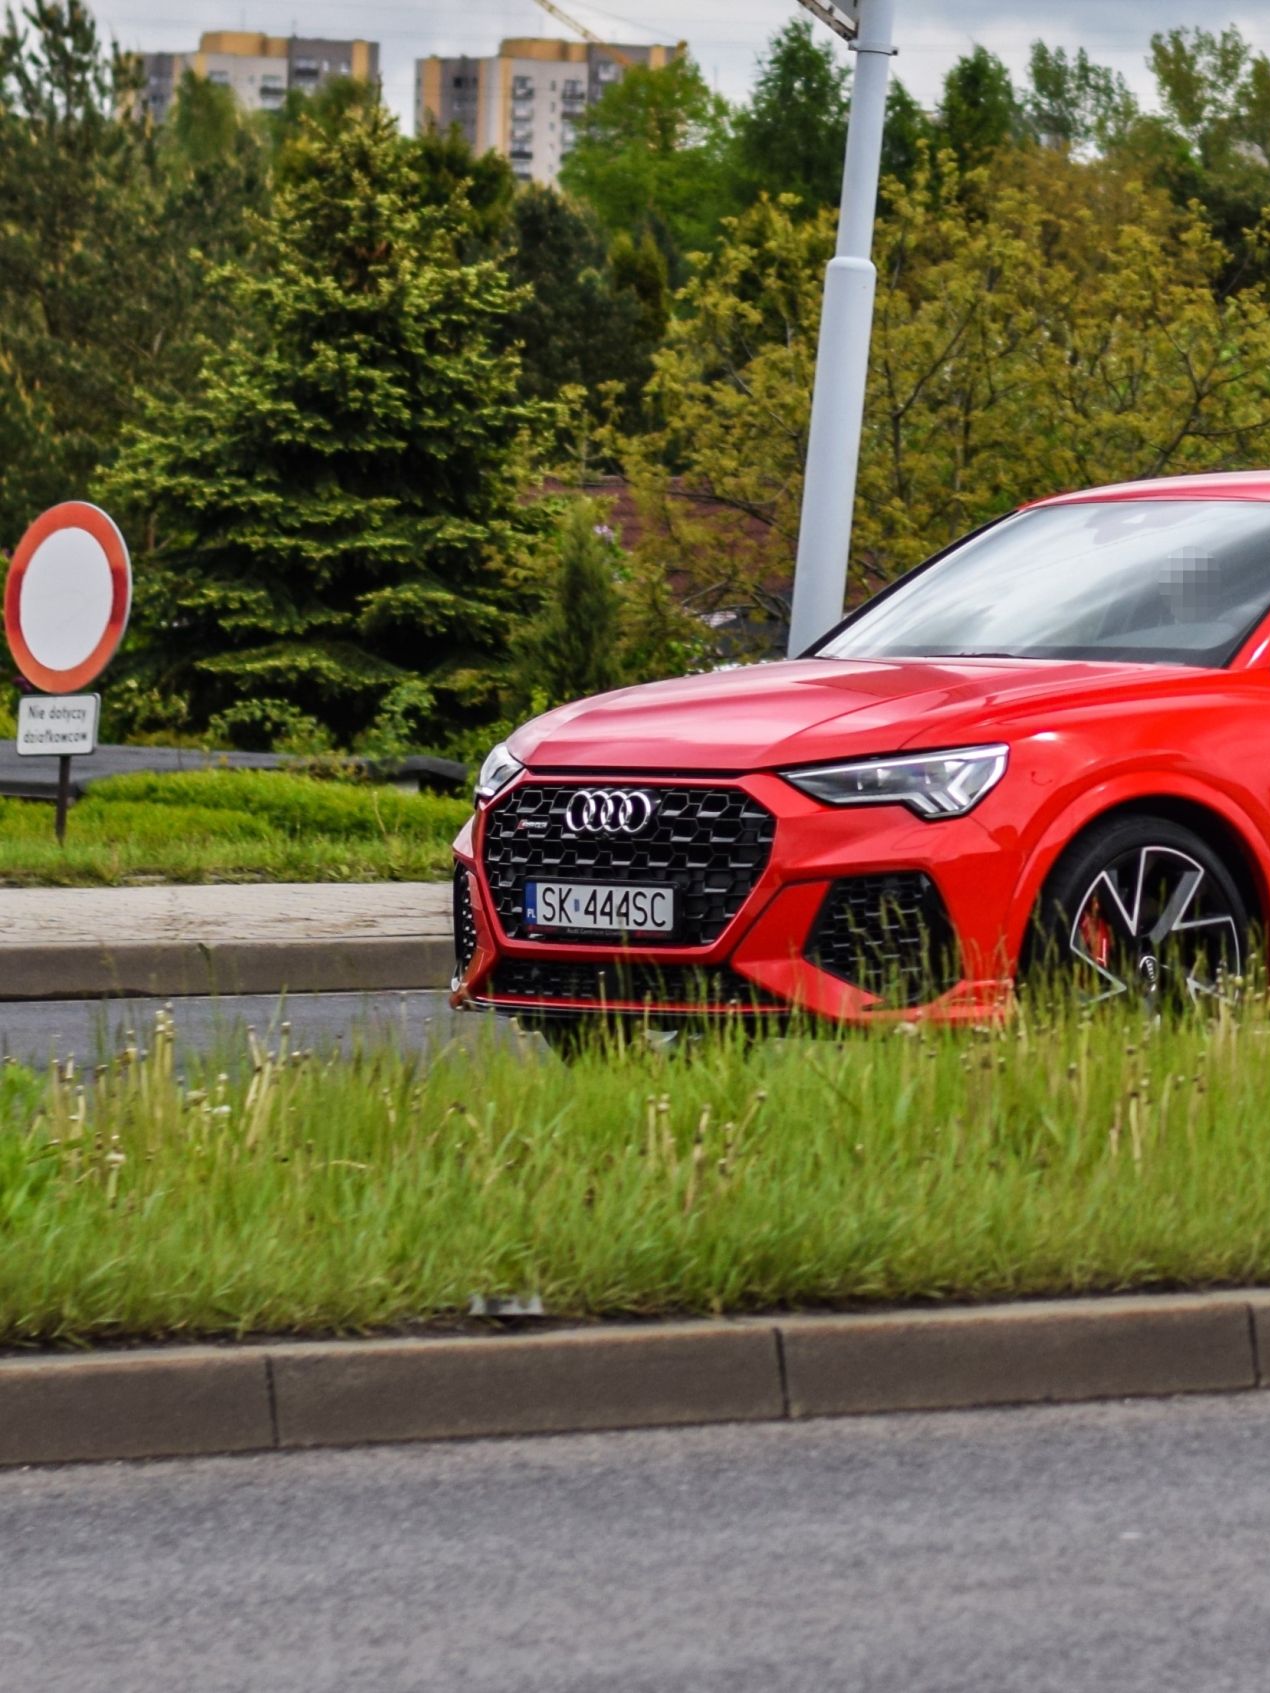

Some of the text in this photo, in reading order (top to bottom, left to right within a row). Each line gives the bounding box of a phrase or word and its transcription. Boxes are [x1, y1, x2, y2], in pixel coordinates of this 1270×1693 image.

[28, 704, 86, 723] Nie dotyczy
[527, 908, 536, 919] PL
[542, 886, 667, 927] SK 444SC
